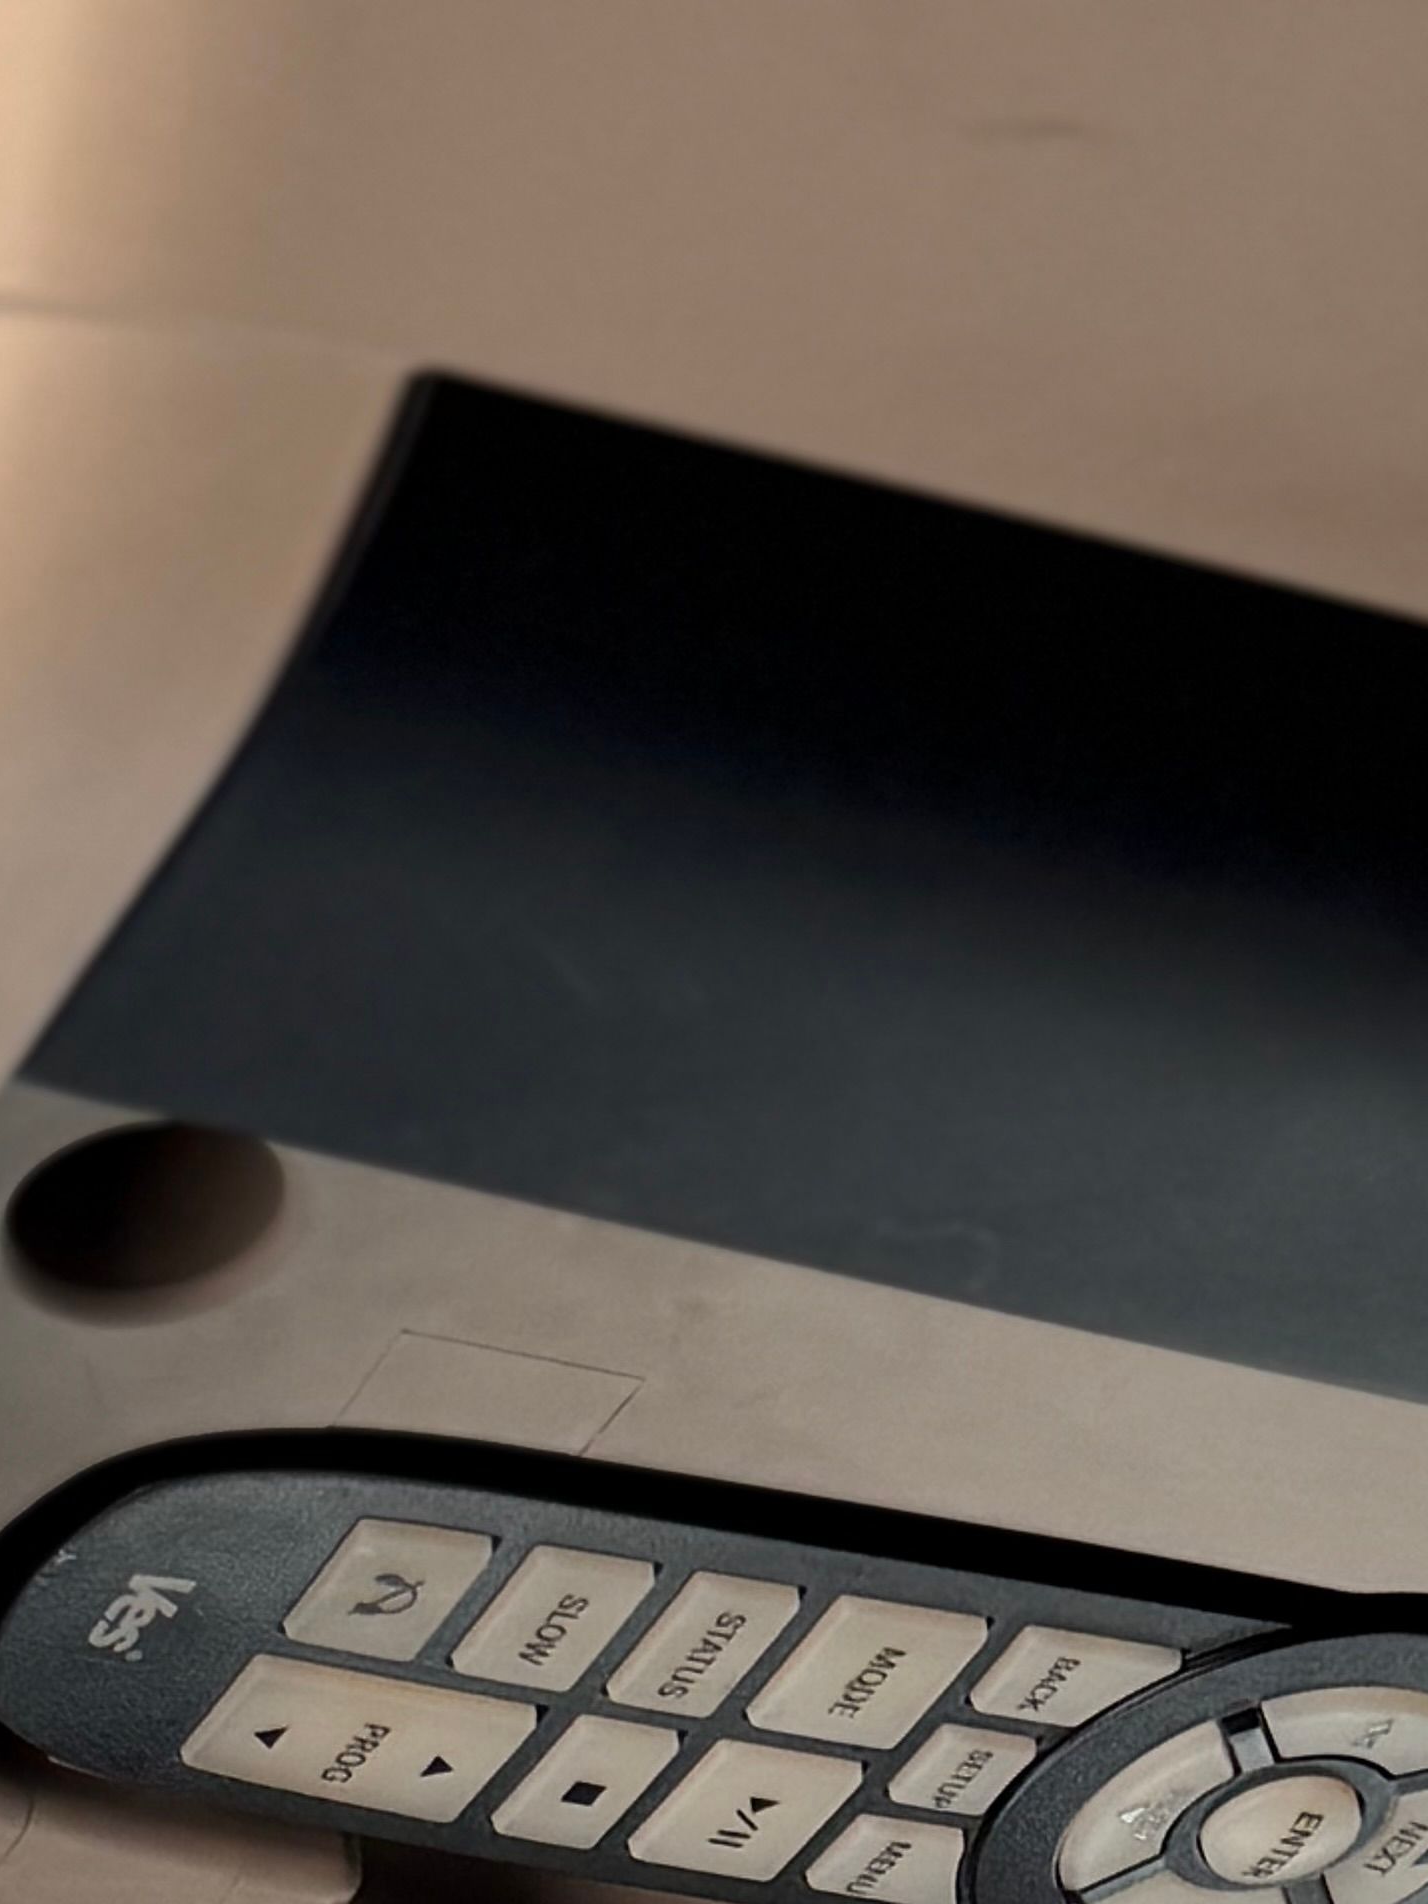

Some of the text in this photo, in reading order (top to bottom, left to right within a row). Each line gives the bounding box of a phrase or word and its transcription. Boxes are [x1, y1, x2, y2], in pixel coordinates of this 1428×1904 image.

[518, 1593, 591, 1667] SLOW
[657, 1611, 748, 1699] STATUS
[827, 1646, 908, 1720] MODE
[1016, 1655, 1081, 1712] BACK
[321, 1722, 392, 1785] PROG
[931, 1748, 995, 1810] SETUP
[845, 1840, 913, 1895] MENU
[1242, 1810, 1326, 1880] ENTER
